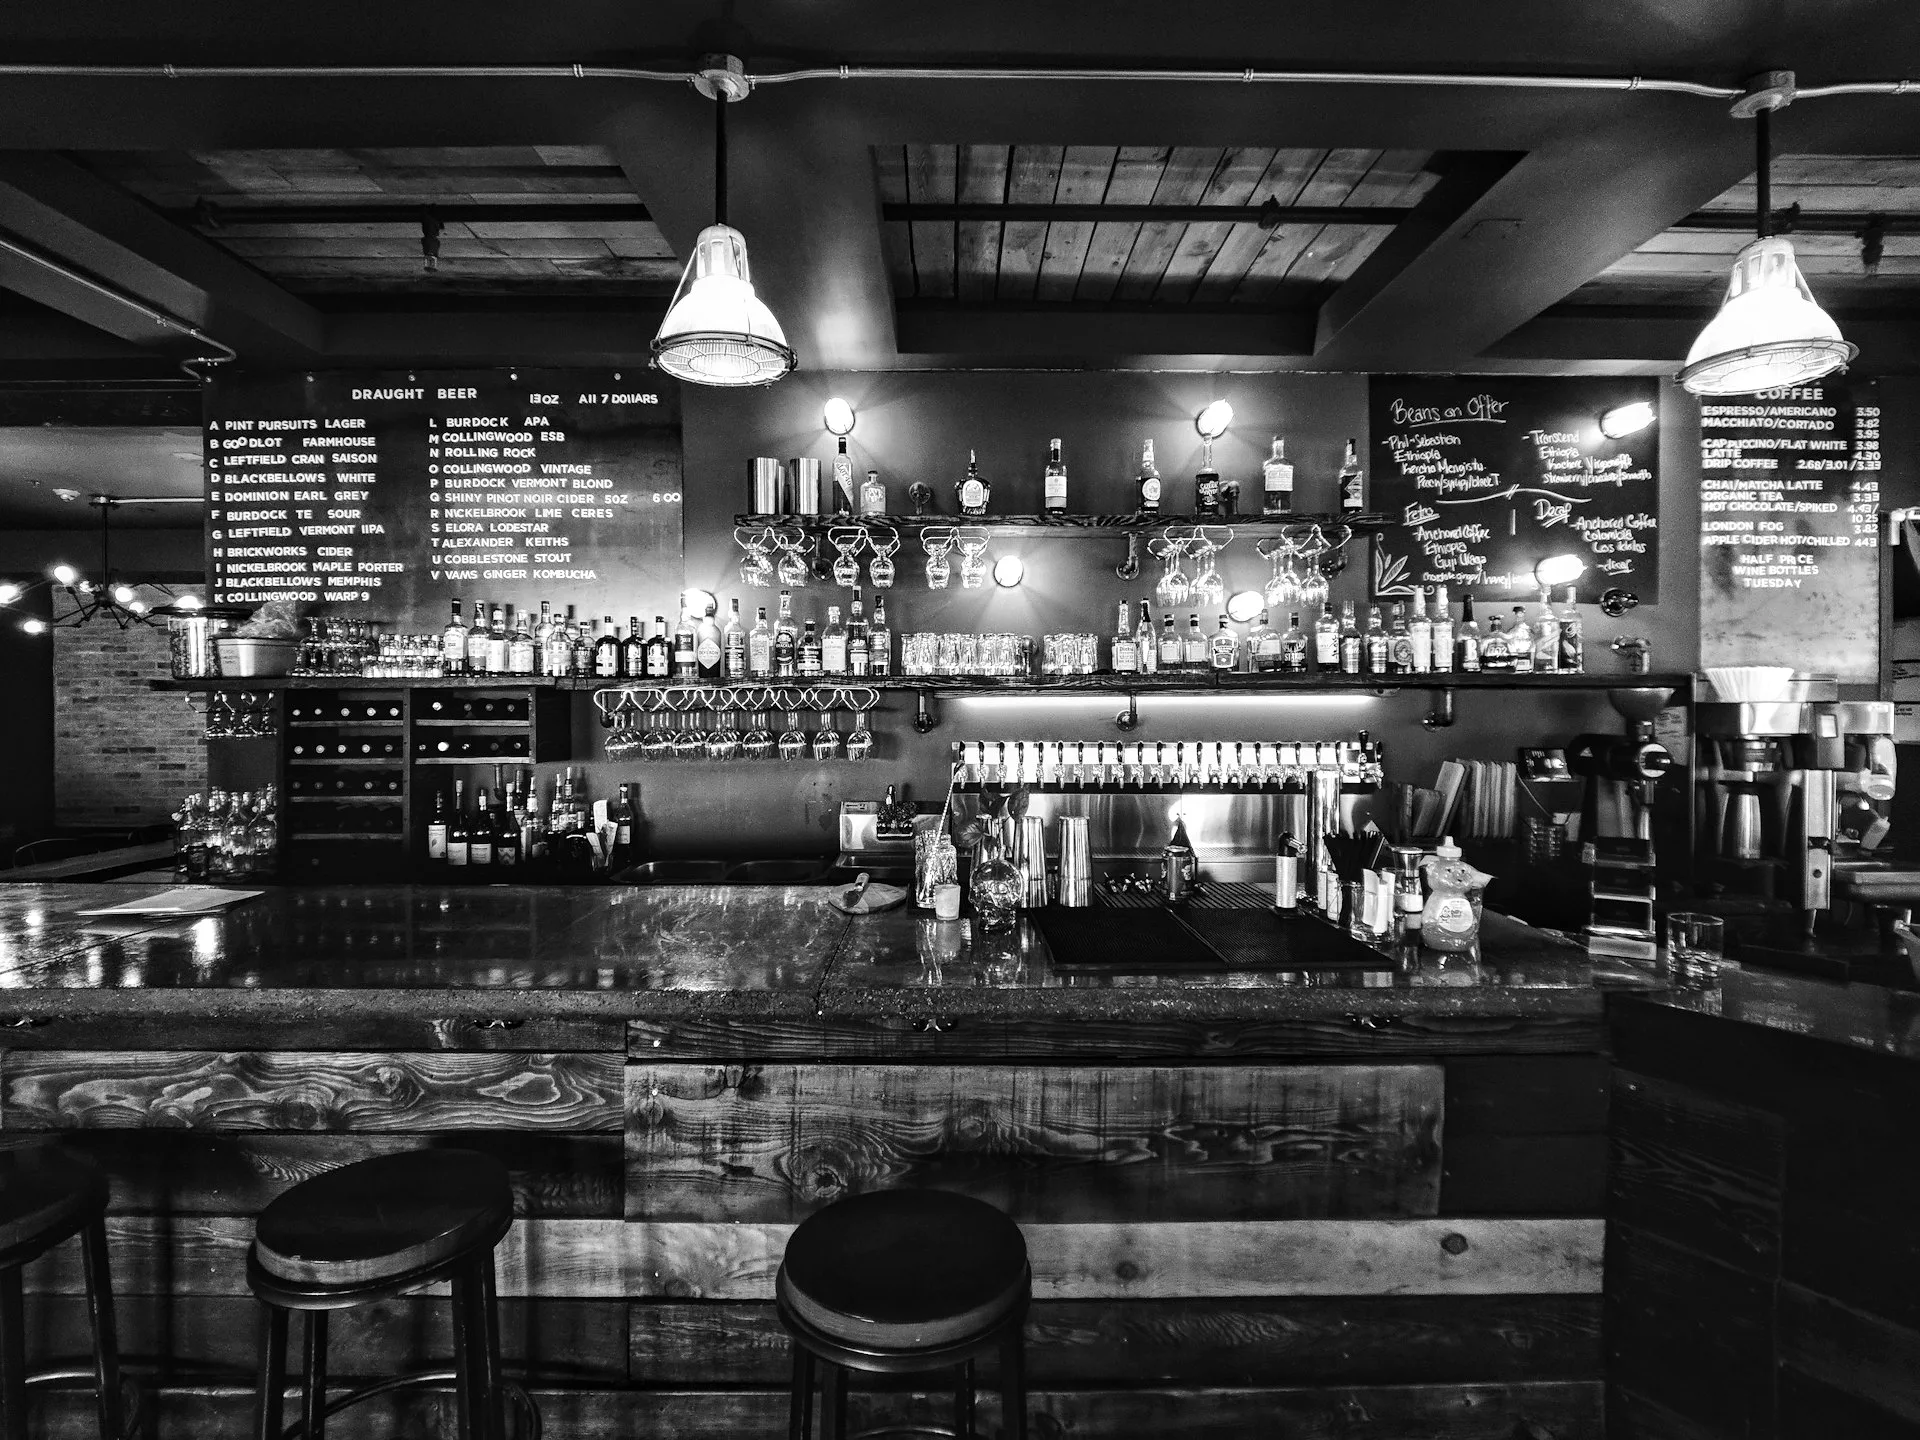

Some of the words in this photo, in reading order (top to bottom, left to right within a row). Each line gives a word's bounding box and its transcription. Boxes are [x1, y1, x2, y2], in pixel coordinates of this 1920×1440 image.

[352, 389, 424, 399] DRAUGHT
[438, 388, 477, 399] BEER
[601, 394, 608, 403] 7
[1755, 388, 1823, 400] COFFEE
[1391, 398, 1440, 424] Beans
[1444, 406, 1462, 418] on
[1468, 394, 1509, 420] Offer
[1857, 408, 1880, 416] 3.50
[210, 421, 218, 430] A
[226, 421, 254, 430] PINT
[258, 420, 317, 430] PURSUITS
[325, 419, 365, 428] LAGER
[430, 418, 437, 427] L
[447, 417, 508, 427] BURDOCK
[524, 417, 549, 426] APA
[1857, 418, 1879, 428] 3.82
[429, 434, 439, 444] M
[442, 432, 532, 442] COLLINGWOOD
[541, 432, 564, 441] ESB
[1856, 430, 1879, 439] 3.95
[210, 439, 219, 448] B
[303, 437, 375, 447] FARMHOUSE
[1809, 441, 1847, 450] WHITE
[1856, 441, 1879, 450] 3.98
[430, 448, 439, 457] N
[445, 448, 498, 457] ROLLING
[504, 448, 536, 458] ROCK
[1702, 448, 1741, 458] LATTE
[209, 459, 218, 468] C
[224, 455, 286, 465] LEFTFIELD
[292, 455, 324, 464] CRAN
[332, 454, 377, 463] SAISON
[1702, 459, 1732, 468] DRIP
[1732, 459, 1777, 468] COFFEE
[443, 464, 531, 474] COLLINGWOOD
[541, 464, 591, 474] VINTAGE
[211, 474, 220, 482] D
[225, 473, 326, 484] BLACKBELLOWS
[337, 473, 375, 482] WHITE
[430, 479, 438, 488] P
[445, 478, 505, 488] BURDOCK
[512, 478, 567, 488] VERMONT
[573, 479, 613, 489] BLOND
[1787, 480, 1822, 490] LATTE
[1852, 482, 1878, 491] 4.43
[212, 492, 219, 500] E
[225, 491, 289, 501] DOMINION
[294, 491, 327, 500] EARL
[334, 491, 368, 501] GREY
[430, 493, 440, 502] Q
[445, 493, 482, 502] SHINY
[487, 494, 520, 503] PINOT
[524, 494, 553, 503] NOIR
[556, 494, 594, 503] CIDER
[1701, 491, 1756, 501] ORGANIC
[1759, 492, 1783, 501] TEA
[1854, 492, 1879, 502] 3.33
[1702, 502, 1727, 512] HOT
[212, 510, 219, 519] F
[227, 510, 287, 521] BURDOCK
[328, 509, 360, 518] SOUR
[431, 509, 439, 518] R
[445, 508, 526, 517] NICKELBROOK
[535, 509, 562, 517] LIME
[572, 508, 613, 518] CERES
[212, 530, 222, 539] G
[229, 527, 292, 538] LEFTFIELD
[299, 525, 355, 535] VERMONT
[432, 523, 439, 532] S
[446, 523, 483, 532] ELORA
[490, 523, 549, 532] LODESTAR
[1702, 522, 1753, 531] LONDON
[1758, 522, 1783, 531] FOG
[1853, 524, 1877, 534] 3.82
[431, 538, 439, 547] T
[442, 537, 513, 548] ALEXANDER
[526, 537, 568, 546] KEITHS
[1701, 535, 1741, 546] APPLE
[1744, 534, 1779, 545] CIDER
[214, 548, 222, 557] H
[228, 547, 307, 557] BRICKWORKS
[317, 547, 352, 556] CIDER
[432, 555, 441, 564] U
[444, 554, 528, 564] COBBLESTONE
[535, 553, 571, 562] STOUT
[1739, 554, 1773, 566] HALF
[227, 563, 306, 573] NICKELBROOK
[313, 562, 352, 571] MAPLE
[358, 563, 403, 572] PORTER
[1733, 566, 1766, 575] WINE
[1768, 565, 1819, 575] BOTTLES
[431, 571, 440, 579] V
[445, 570, 478, 579] VAMS
[483, 570, 527, 579] GINGER
[533, 570, 596, 579] KOMBUCHA
[215, 578, 222, 587] J
[226, 577, 322, 587] BLACKBELLOWS
[328, 577, 381, 586] MEMPHIS
[1743, 578, 1801, 588] TUESDAY
[215, 594, 223, 603] K
[227, 591, 317, 603] COLLINGWOOD
[324, 592, 358, 601] WARP
[361, 592, 369, 601] 9
